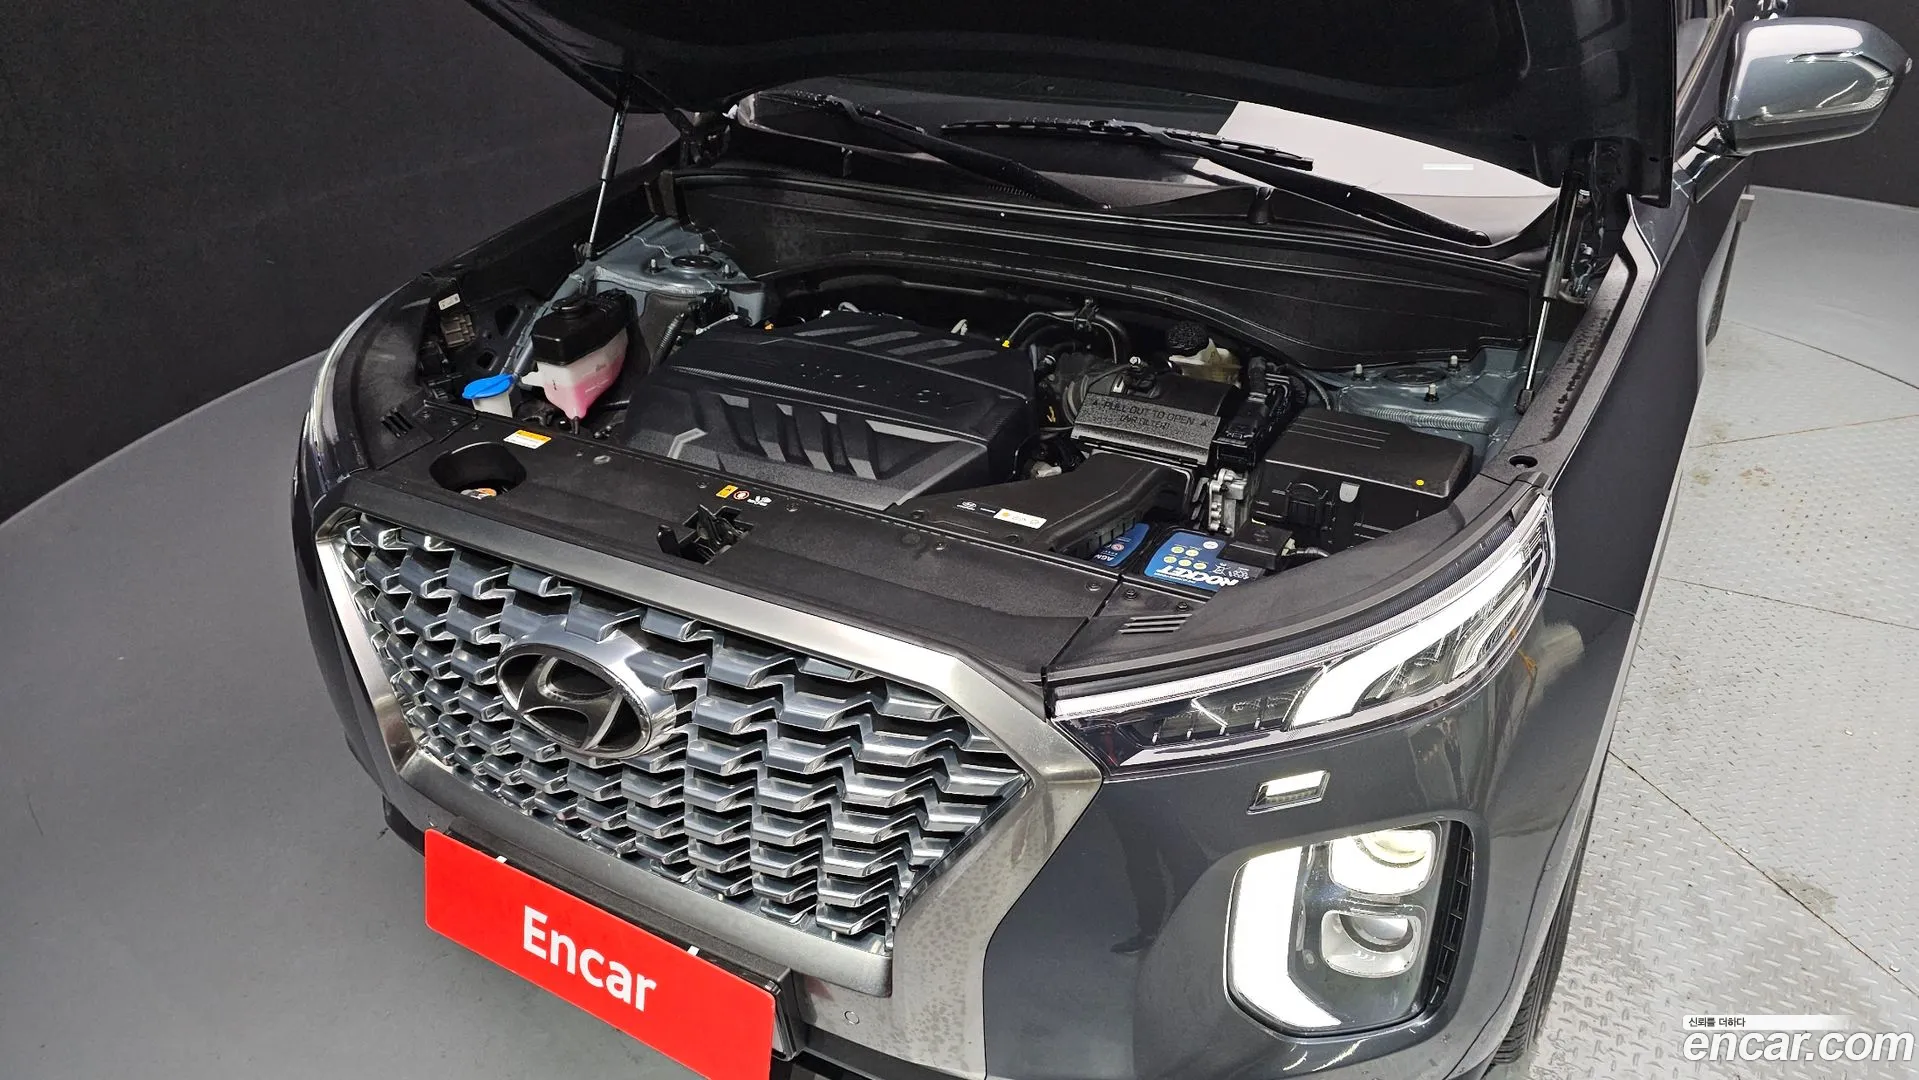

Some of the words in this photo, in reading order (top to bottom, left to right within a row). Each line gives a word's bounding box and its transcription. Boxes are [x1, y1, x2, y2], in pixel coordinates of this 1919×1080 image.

[1103, 401, 1127, 413] PULL
[1129, 405, 1152, 416] OUT
[1152, 408, 1166, 418] TO
[1166, 412, 1196, 426] OPEN
[522, 905, 657, 1012] Encar
